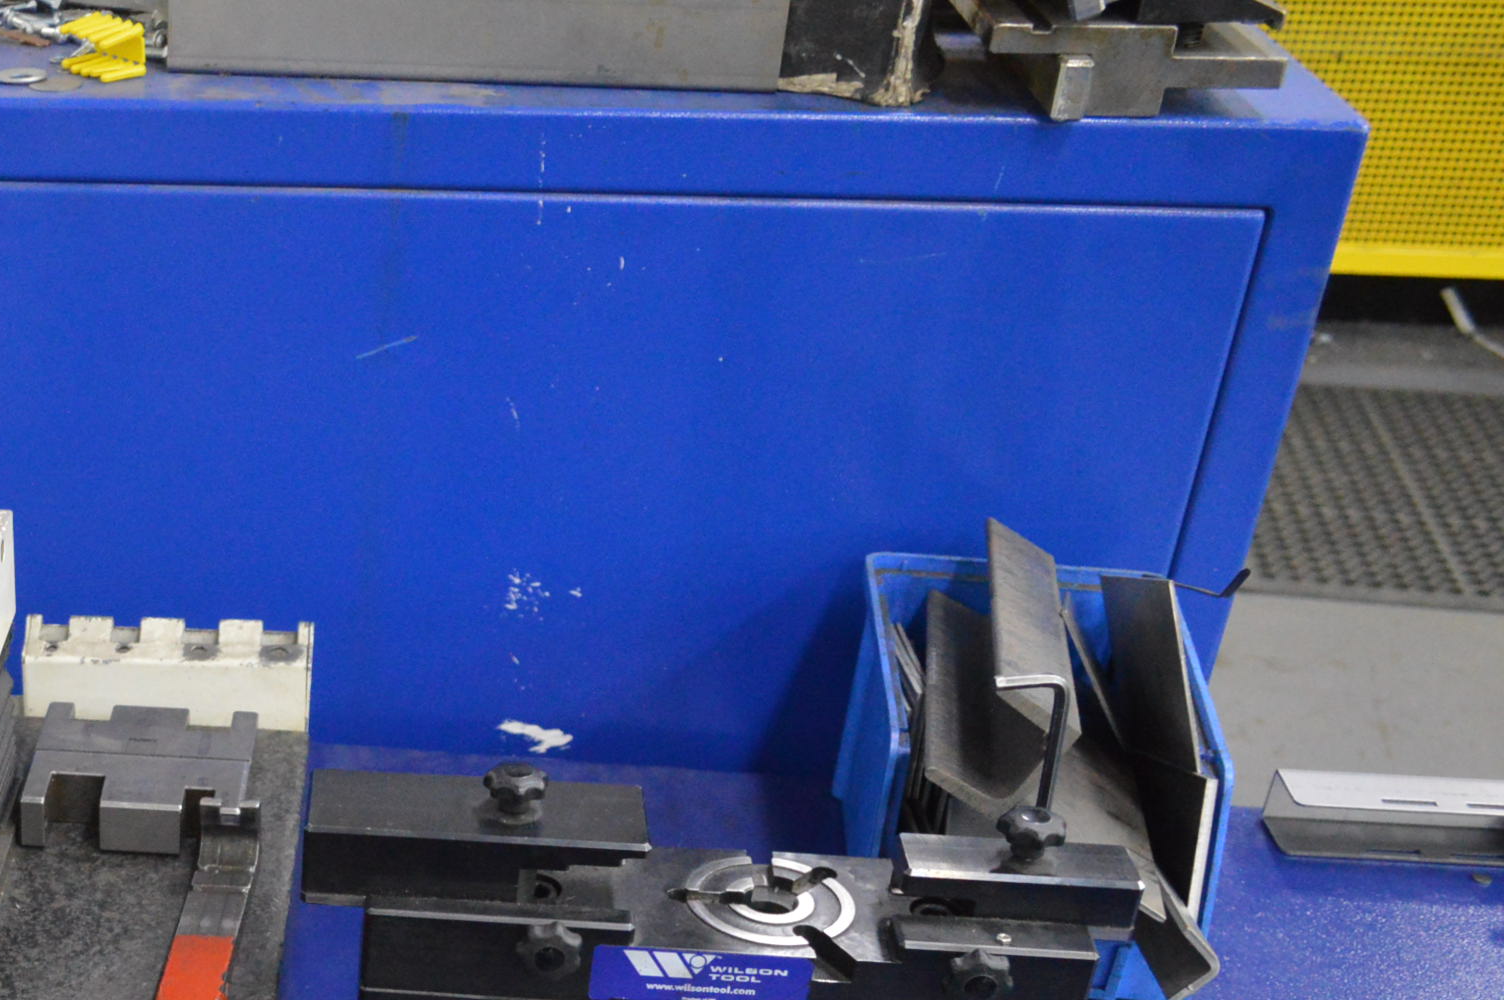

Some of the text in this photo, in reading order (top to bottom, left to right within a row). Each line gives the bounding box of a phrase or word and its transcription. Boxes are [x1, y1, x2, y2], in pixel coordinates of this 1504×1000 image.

[709, 965, 789, 978] WILSON
[708, 973, 762, 984] TOOL
[645, 982, 757, 997] www.wilsontool.com
